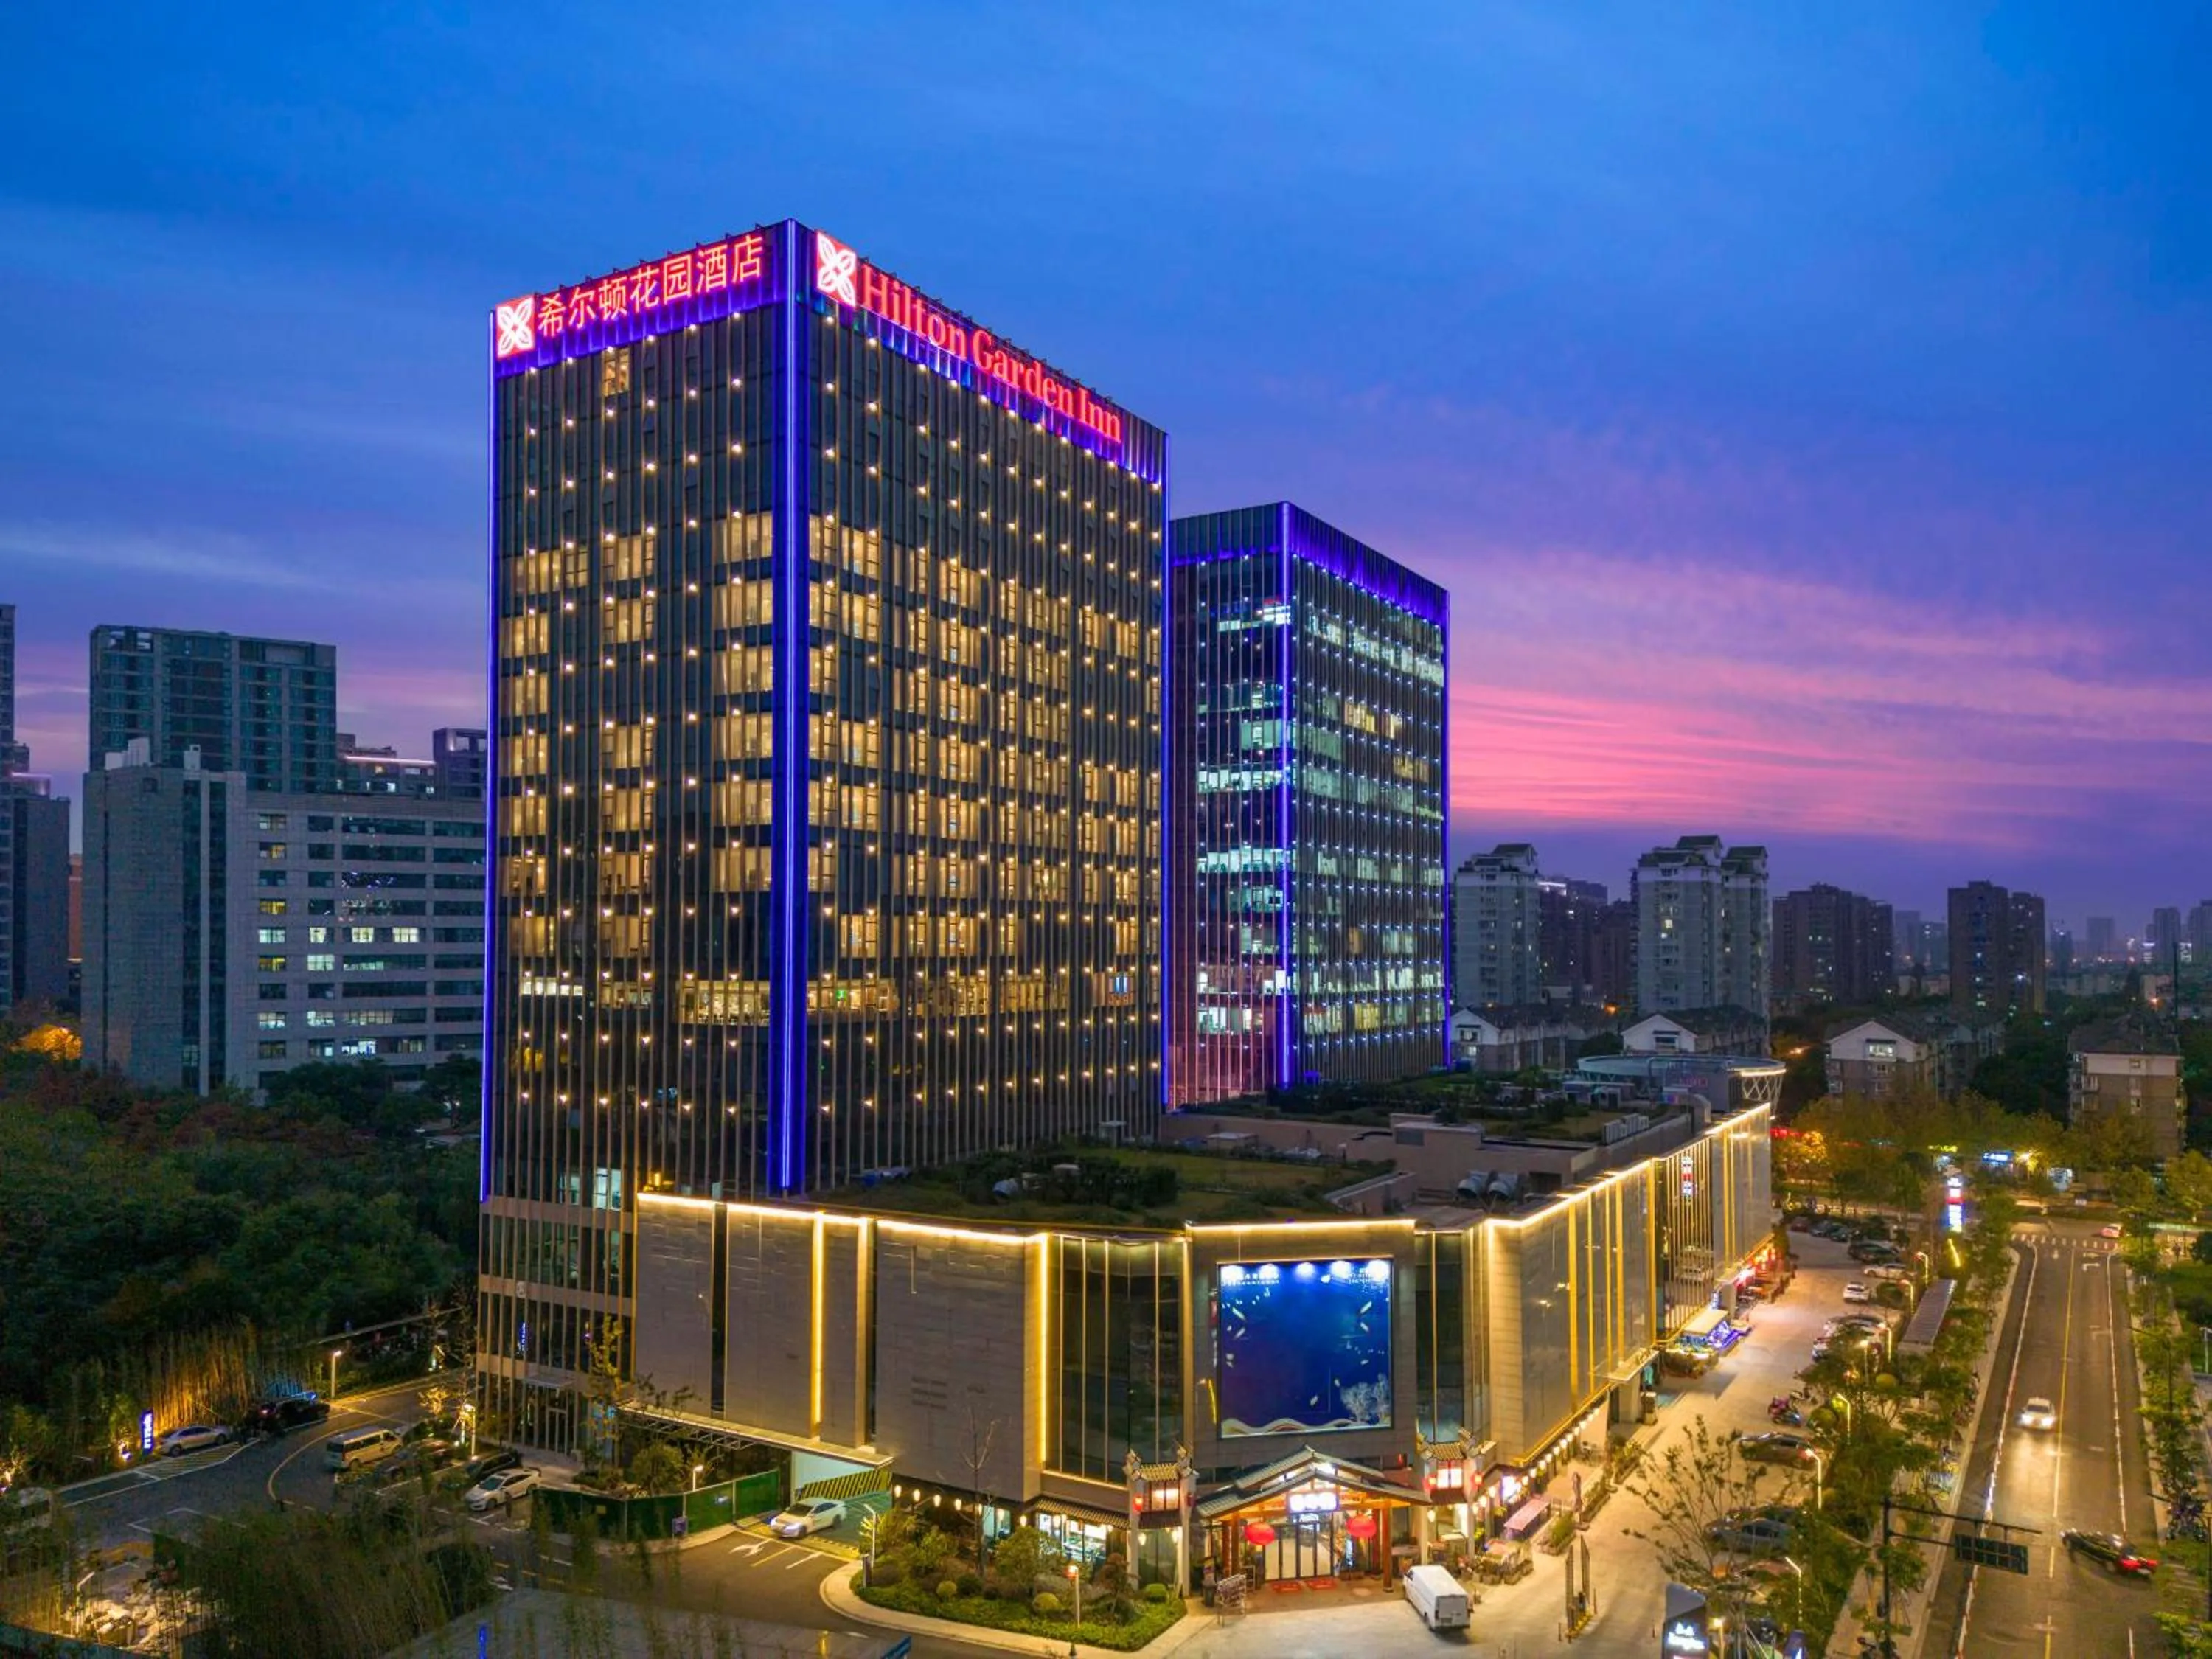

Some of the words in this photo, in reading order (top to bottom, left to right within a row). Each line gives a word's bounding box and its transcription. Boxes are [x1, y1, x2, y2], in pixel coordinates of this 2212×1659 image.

[537, 234, 764, 337] 希尔顿花园酒店
[861, 262, 967, 361] Hilton
[973, 329, 1074, 417] Garden
[1077, 384, 1121, 443] Inn
